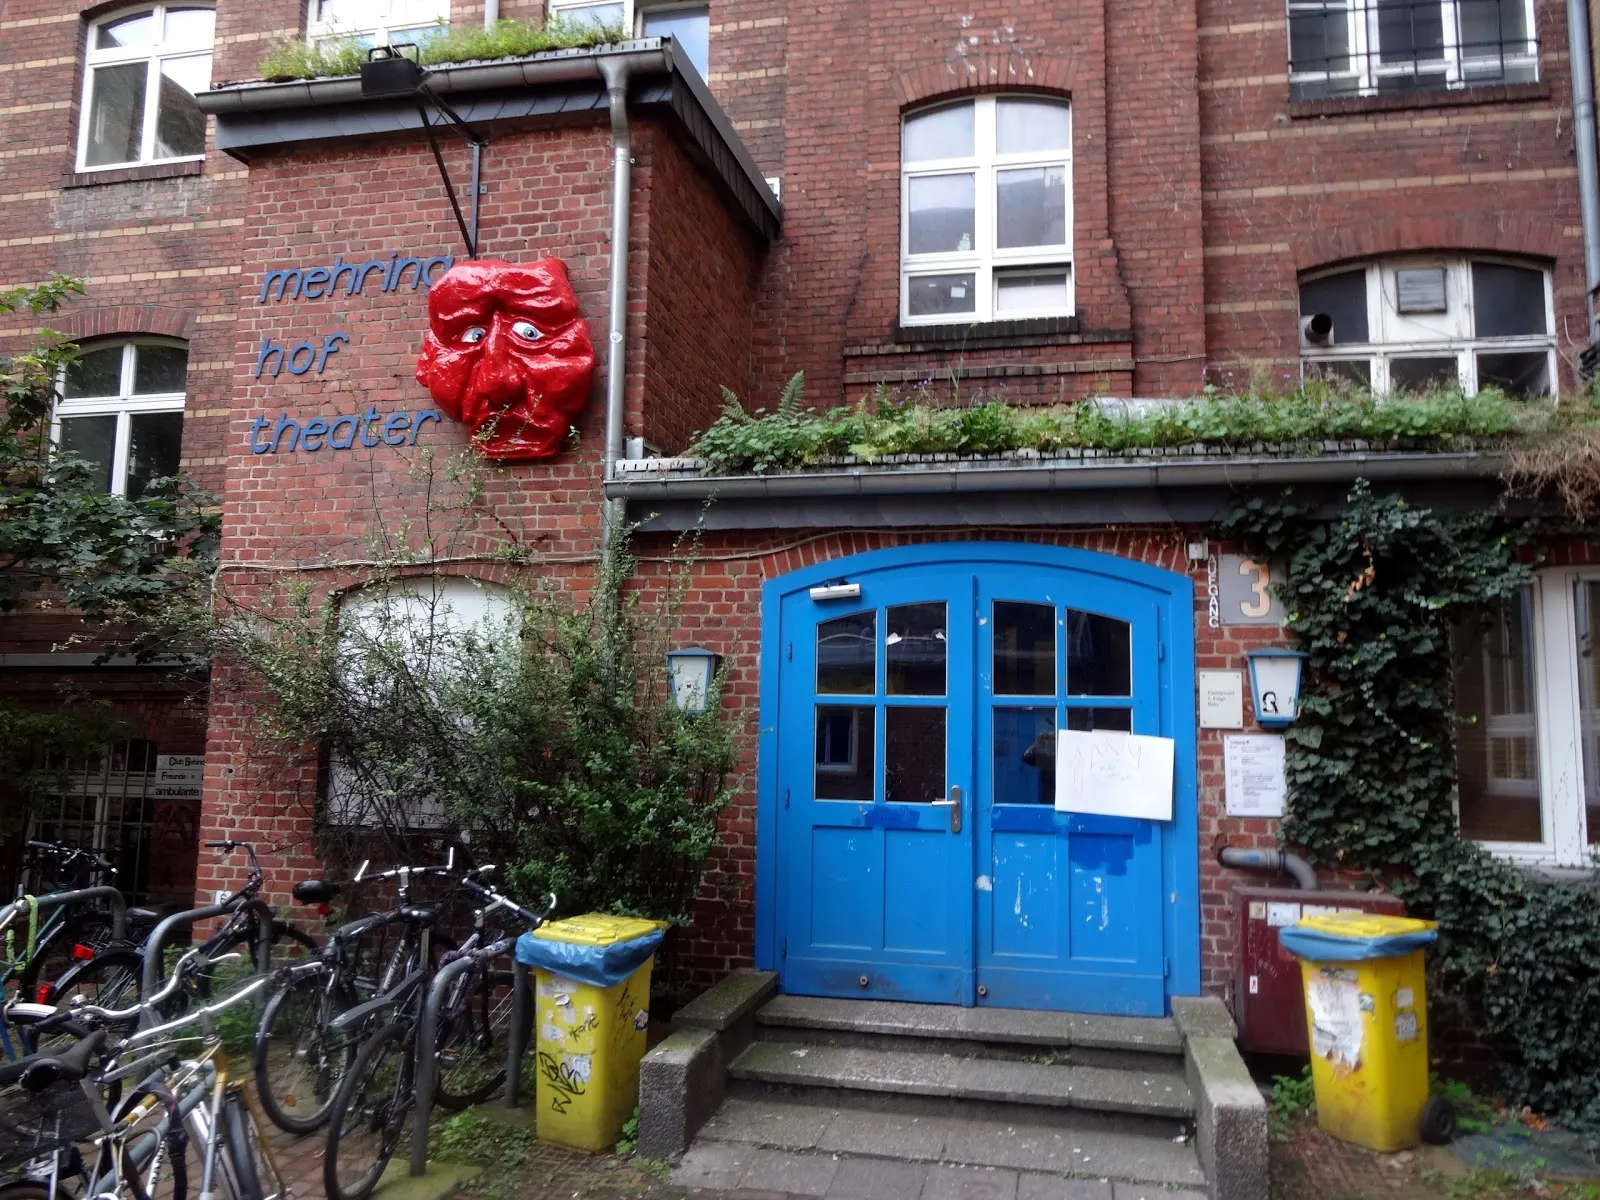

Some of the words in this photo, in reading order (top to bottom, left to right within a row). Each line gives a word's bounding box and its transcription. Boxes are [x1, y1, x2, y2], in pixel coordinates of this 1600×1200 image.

[260, 251, 455, 304] mehring
[254, 332, 349, 378] hof
[250, 407, 441, 454] theater
[1207, 554, 1219, 629] AUFGANG
[1239, 559, 1271, 618] 3
[161, 771, 187, 781] Freunde
[169, 757, 183, 767] Club
[155, 786, 199, 796] ambulante
